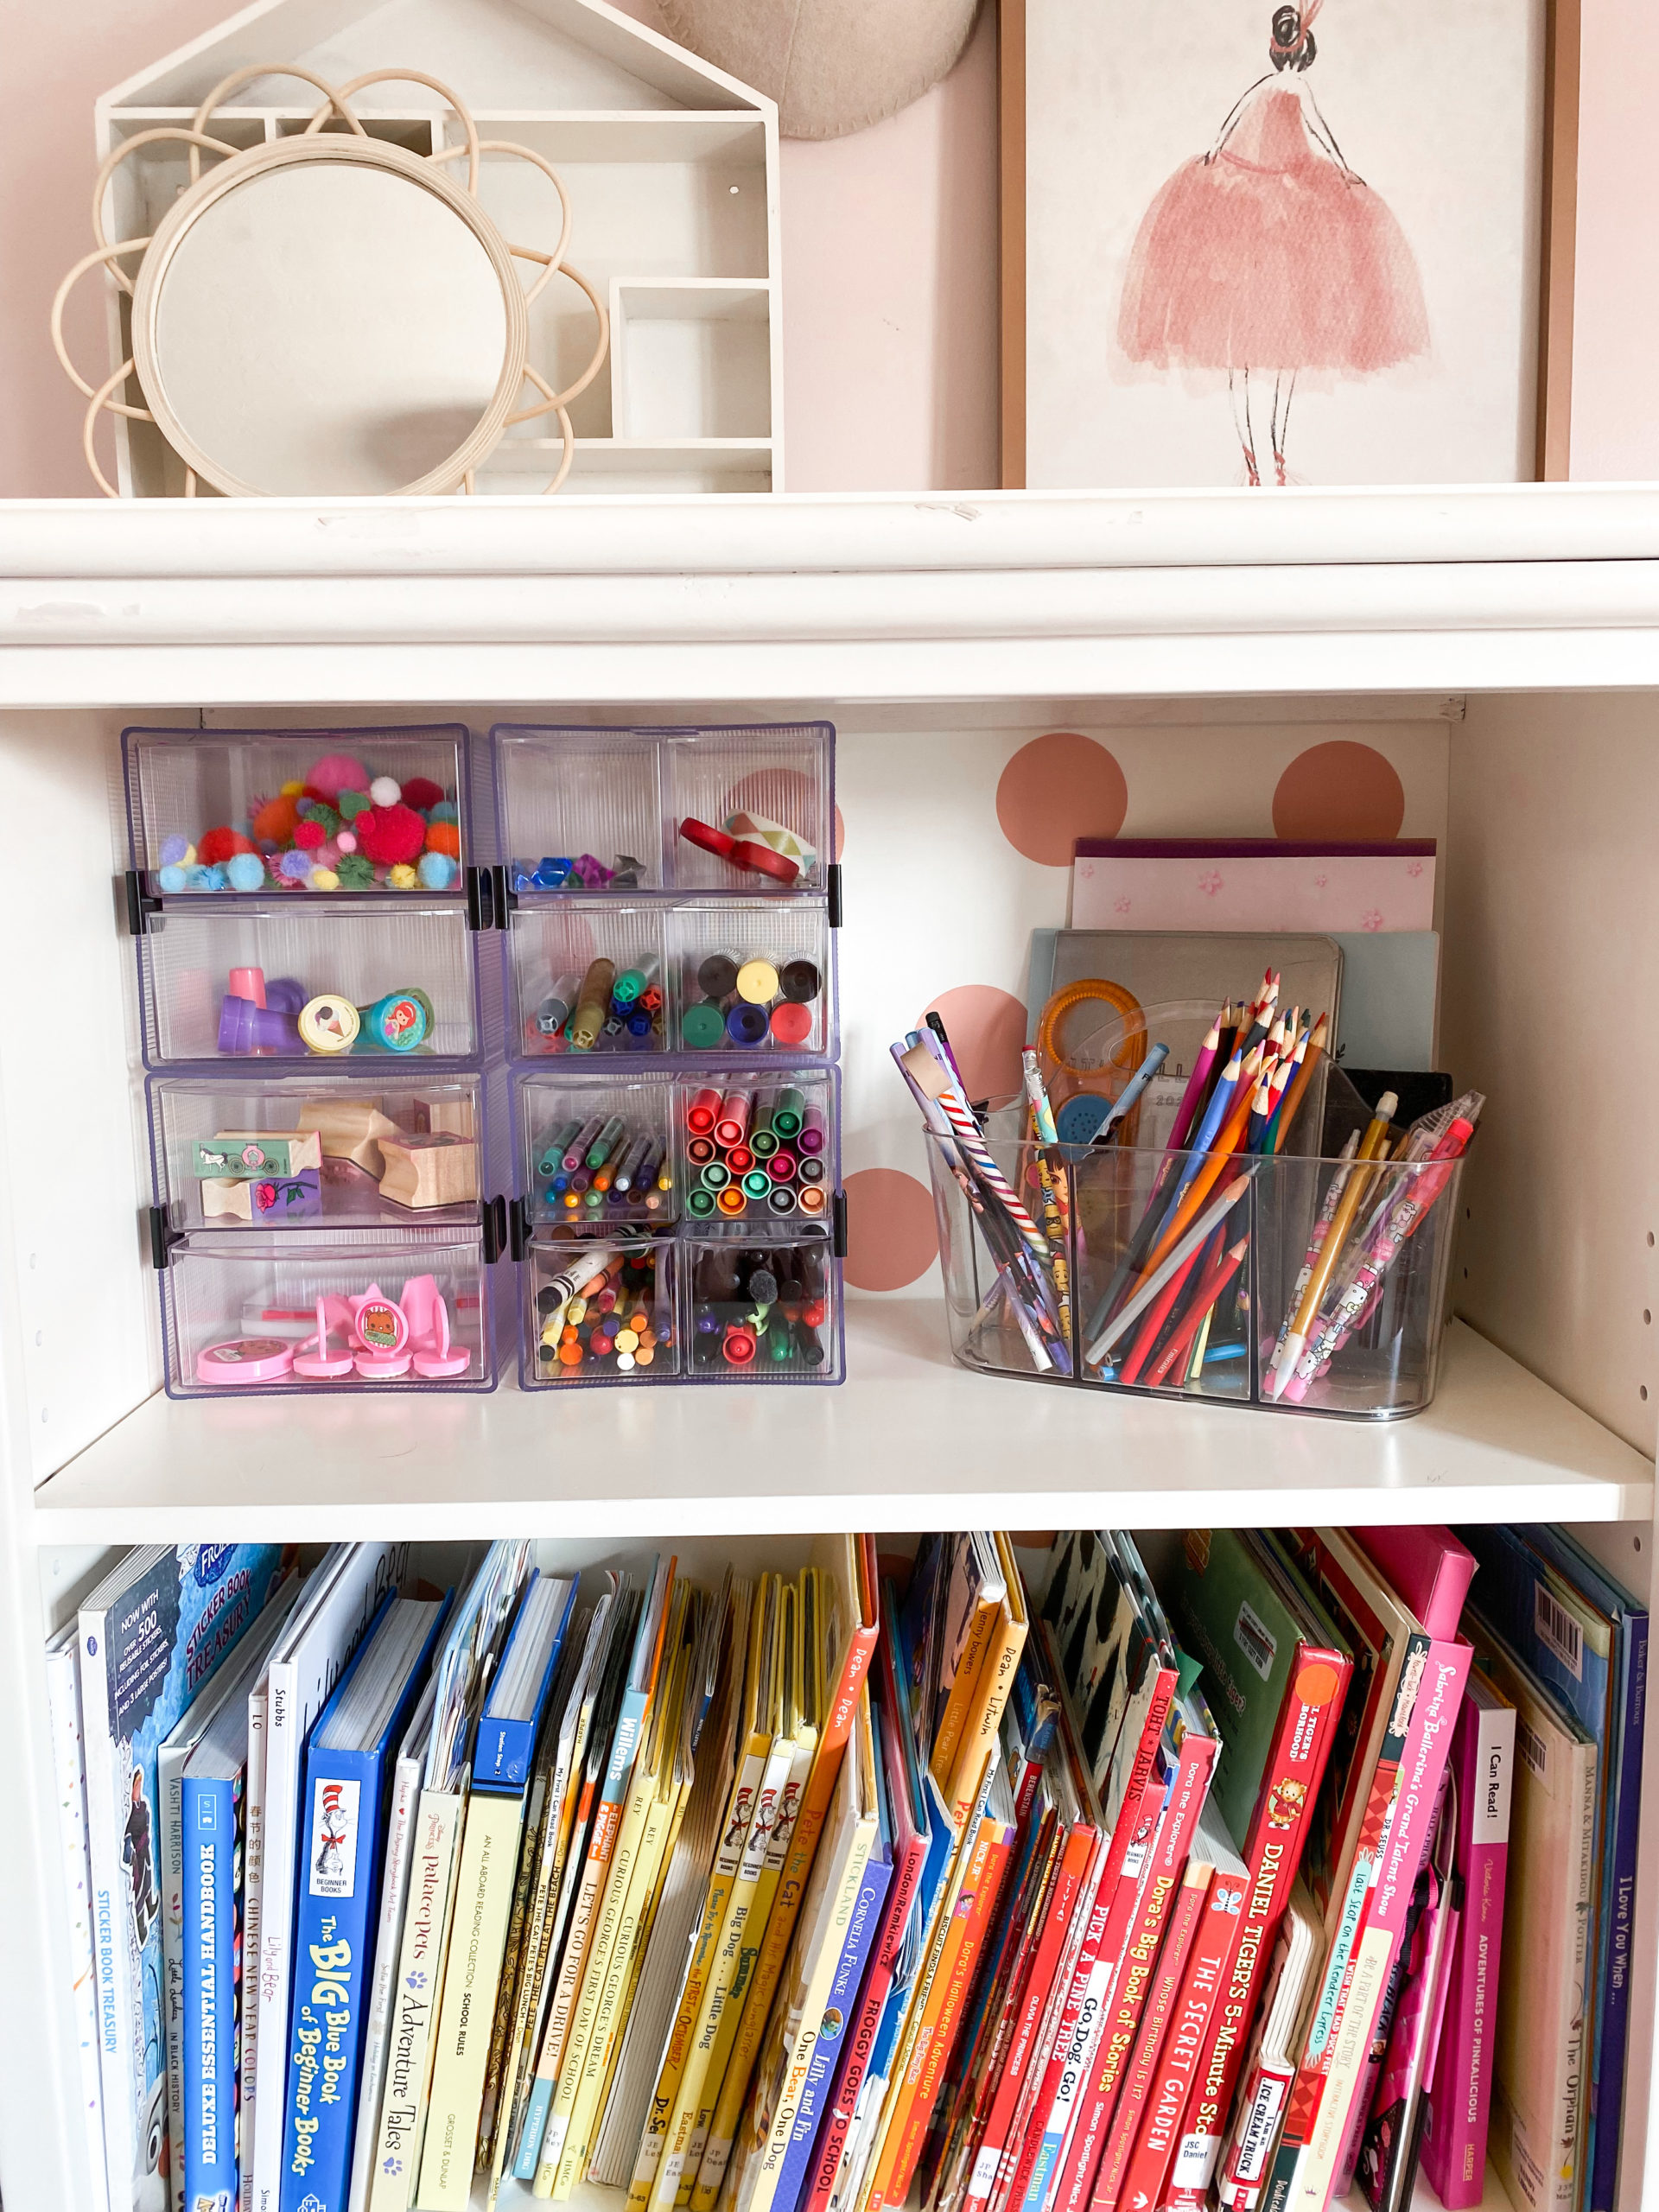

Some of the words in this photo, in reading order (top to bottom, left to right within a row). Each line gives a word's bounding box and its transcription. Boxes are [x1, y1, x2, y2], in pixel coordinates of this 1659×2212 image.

[1158, 1349, 1179, 1374] Emirates
[121, 1610, 141, 1634] NOW
[141, 1589, 159, 1612] WITH
[186, 1589, 225, 1662] STICKER
[226, 1568, 251, 1598] BOOK
[972, 1608, 992, 1638] jenny
[124, 1637, 137, 1657] OVER
[138, 1611, 157, 1642] 500
[186, 1599, 251, 1694] TREASURY
[848, 1648, 867, 1678] Dean
[963, 1639, 982, 1675] bowers
[997, 1646, 1017, 1677] Dean
[275, 1688, 286, 1728] Stubbs
[1425, 1661, 1457, 1722] Sabrina
[835, 1697, 853, 1728] Dean
[980, 1696, 1004, 1735] Litwin
[1147, 1695, 1170, 1737] TOHT
[577, 1719, 586, 1745] HARPER
[608, 1717, 638, 1782] Willems
[1299, 1717, 1319, 1761] TIGER'S
[1409, 1715, 1448, 1791] Ballerina's
[1489, 1753, 1502, 1778] Can
[1128, 1747, 1154, 1803] JARVIS
[1582, 1765, 1596, 1813] MANNA
[169, 1777, 181, 1813] VASHTI
[632, 1796, 644, 1816] REY
[1018, 1774, 1038, 1818] BERENSTAIN
[1486, 1783, 1500, 1819] Read!
[645, 1826, 657, 1846] REY
[798, 1808, 823, 1846] Pete
[1383, 1818, 1392, 1835] DR.
[1397, 1794, 1420, 1840] Grand
[1583, 1815, 1592, 1826] &
[169, 1821, 181, 1875] HARRISON
[483, 1851, 492, 1863] ALL
[485, 1834, 493, 1849] AN
[1376, 1834, 1388, 1859] SEUSS
[608, 1849, 631, 1905] CURIOUS
[790, 1851, 808, 1874] the
[989, 1853, 999, 1872] Dora
[1386, 1840, 1411, 1882] Talent
[1579, 1827, 1592, 1897] MITAKIDOU
[315, 1878, 347, 1887] BEGINNER
[321, 1885, 342, 1894] BOOKS
[477, 1865, 491, 1899] ABOARD
[779, 1879, 801, 1909] Cat
[836, 1842, 868, 1927] STICKLAND
[976, 1880, 990, 1916] Explorer
[1248, 1842, 1285, 1920] DANIEL
[1377, 1881, 1397, 1917] Show
[97, 1890, 111, 1943] STICKER
[200, 1844, 215, 1960] HANDBOOK
[471, 1899, 486, 1937] READING
[577, 1882, 598, 1926] LET'S
[730, 1905, 748, 1929] Big
[847, 1887, 877, 1950] CORNELIA
[880, 1851, 920, 1967] London/Remkiewicz
[1143, 1875, 1175, 1929] Dora's
[247, 1897, 259, 1957] CHINESE
[321, 1915, 337, 1943] The
[571, 1926, 588, 1950] GO
[594, 1907, 616, 1970] GEORGE'S
[773, 1916, 788, 1936] and
[1085, 1905, 1110, 1944] PICK
[1575, 1916, 1588, 1966] POTTER
[465, 1938, 480, 1989] COLLECTION
[613, 1916, 634, 1973] CURIOUS
[722, 1931, 741, 1958] Dog
[767, 1942, 782, 1959] His
[957, 1942, 975, 1977] Dora's
[1079, 1949, 1096, 1963] A
[1129, 1932, 1159, 1961] Big
[1228, 1924, 1264, 2000] TIGER'S
[100, 1947, 114, 1984] BOOK
[245, 1965, 258, 1994] NEW
[309, 1938, 353, 2006] BIG
[563, 1955, 582, 1990] FOR
[754, 1962, 777, 1994] Magic
[833, 1952, 858, 1998] FUNKE
[1192, 1956, 1222, 1993] THE
[1473, 1934, 1489, 2016] ADVENTURES
[558, 1990, 573, 2003] A
[583, 1971, 602, 2005] FIRST
[597, 1974, 620, 2032] GEORGE'S
[709, 1986, 728, 2020] Little
[1065, 1971, 1091, 2012] PINE
[1122, 1965, 1150, 2005] Book
[1155, 1975, 1176, 2013] Whose
[102, 1987, 117, 2055] TREASURY
[201, 1963, 217, 2080] ESSENTIAL
[243, 2004, 257, 2041] YEAR
[301, 2005, 319, 2025] of
[459, 1993, 472, 2028] SCHOOL
[578, 2006, 593, 2031] DAY
[939, 1980, 963, 2038] Halloween
[1027, 1995, 1040, 2021] OLIVIA
[1077, 1997, 1098, 2025] Go,
[1116, 2009, 1137, 2031] of
[1473, 2018, 1484, 2036] OF
[325, 2009, 351, 2053] Blue
[392, 1993, 429, 2098] Adventure
[455, 2031, 467, 2057] RULES
[546, 2008, 569, 2059] DRIVE!
[572, 2032, 586, 2050] OF
[698, 2023, 718, 2050] Dog
[738, 2001, 766, 2060] Sunglasses
[796, 2031, 817, 2061] One
[1021, 2022, 1032, 2037] THE
[1051, 2018, 1076, 2063] TREE
[1067, 2025, 1090, 2066] Dog.
[1138, 2016, 1164, 2067] Birthday
[1170, 1999, 1208, 2072] SECRET
[586, 2036, 605, 2078] DREAM
[806, 2053, 830, 2087] Lilly
[1010, 2037, 1028, 2076] PRINCESS
[1097, 2031, 1132, 2094] Stories
[1205, 2004, 1243, 2098] 5-Minute
[1567, 2037, 1581, 2066] The
[243, 2048, 257, 2102] COLORS
[293, 2027, 322, 2116] Beginner
[319, 2056, 347, 2106] Book
[560, 2052, 581, 2101] SCHOOL
[783, 2065, 807, 2103] Bear,
[919, 2041, 944, 2100] Adventure
[1056, 2070, 1077, 2103] Go!
[1136, 2069, 1149, 2081] Is
[1467, 2037, 1482, 2124] PINKALICIOUS
[800, 2088, 816, 2117] and
[1130, 2083, 1145, 2101] It?
[1259, 2082, 1274, 2102] ICE
[1562, 2074, 1580, 2134] Orphan
[201, 2083, 217, 2164] DELUXE
[385, 2104, 416, 2151] Tales
[775, 2107, 795, 2138] One
[792, 2119, 812, 2142] Fin
[1089, 2101, 1105, 2133] Simon
[1147, 2078, 1185, 2152] GARDEN
[1248, 2103, 1268, 2138] CREAM
[291, 2116, 320, 2177] Books
[762, 2140, 787, 2171] Dog
[1183, 2149, 1208, 2159] Daniel
[1185, 2140, 1200, 2149] JSC
[1238, 2139, 1258, 2174] TRUCK
[1465, 2144, 1475, 2182] HARPER
[976, 2171, 994, 2181] Sha
[1027, 2142, 1058, 2202] Eastman
[1068, 2133, 1096, 2207] Spotlight/Nick
